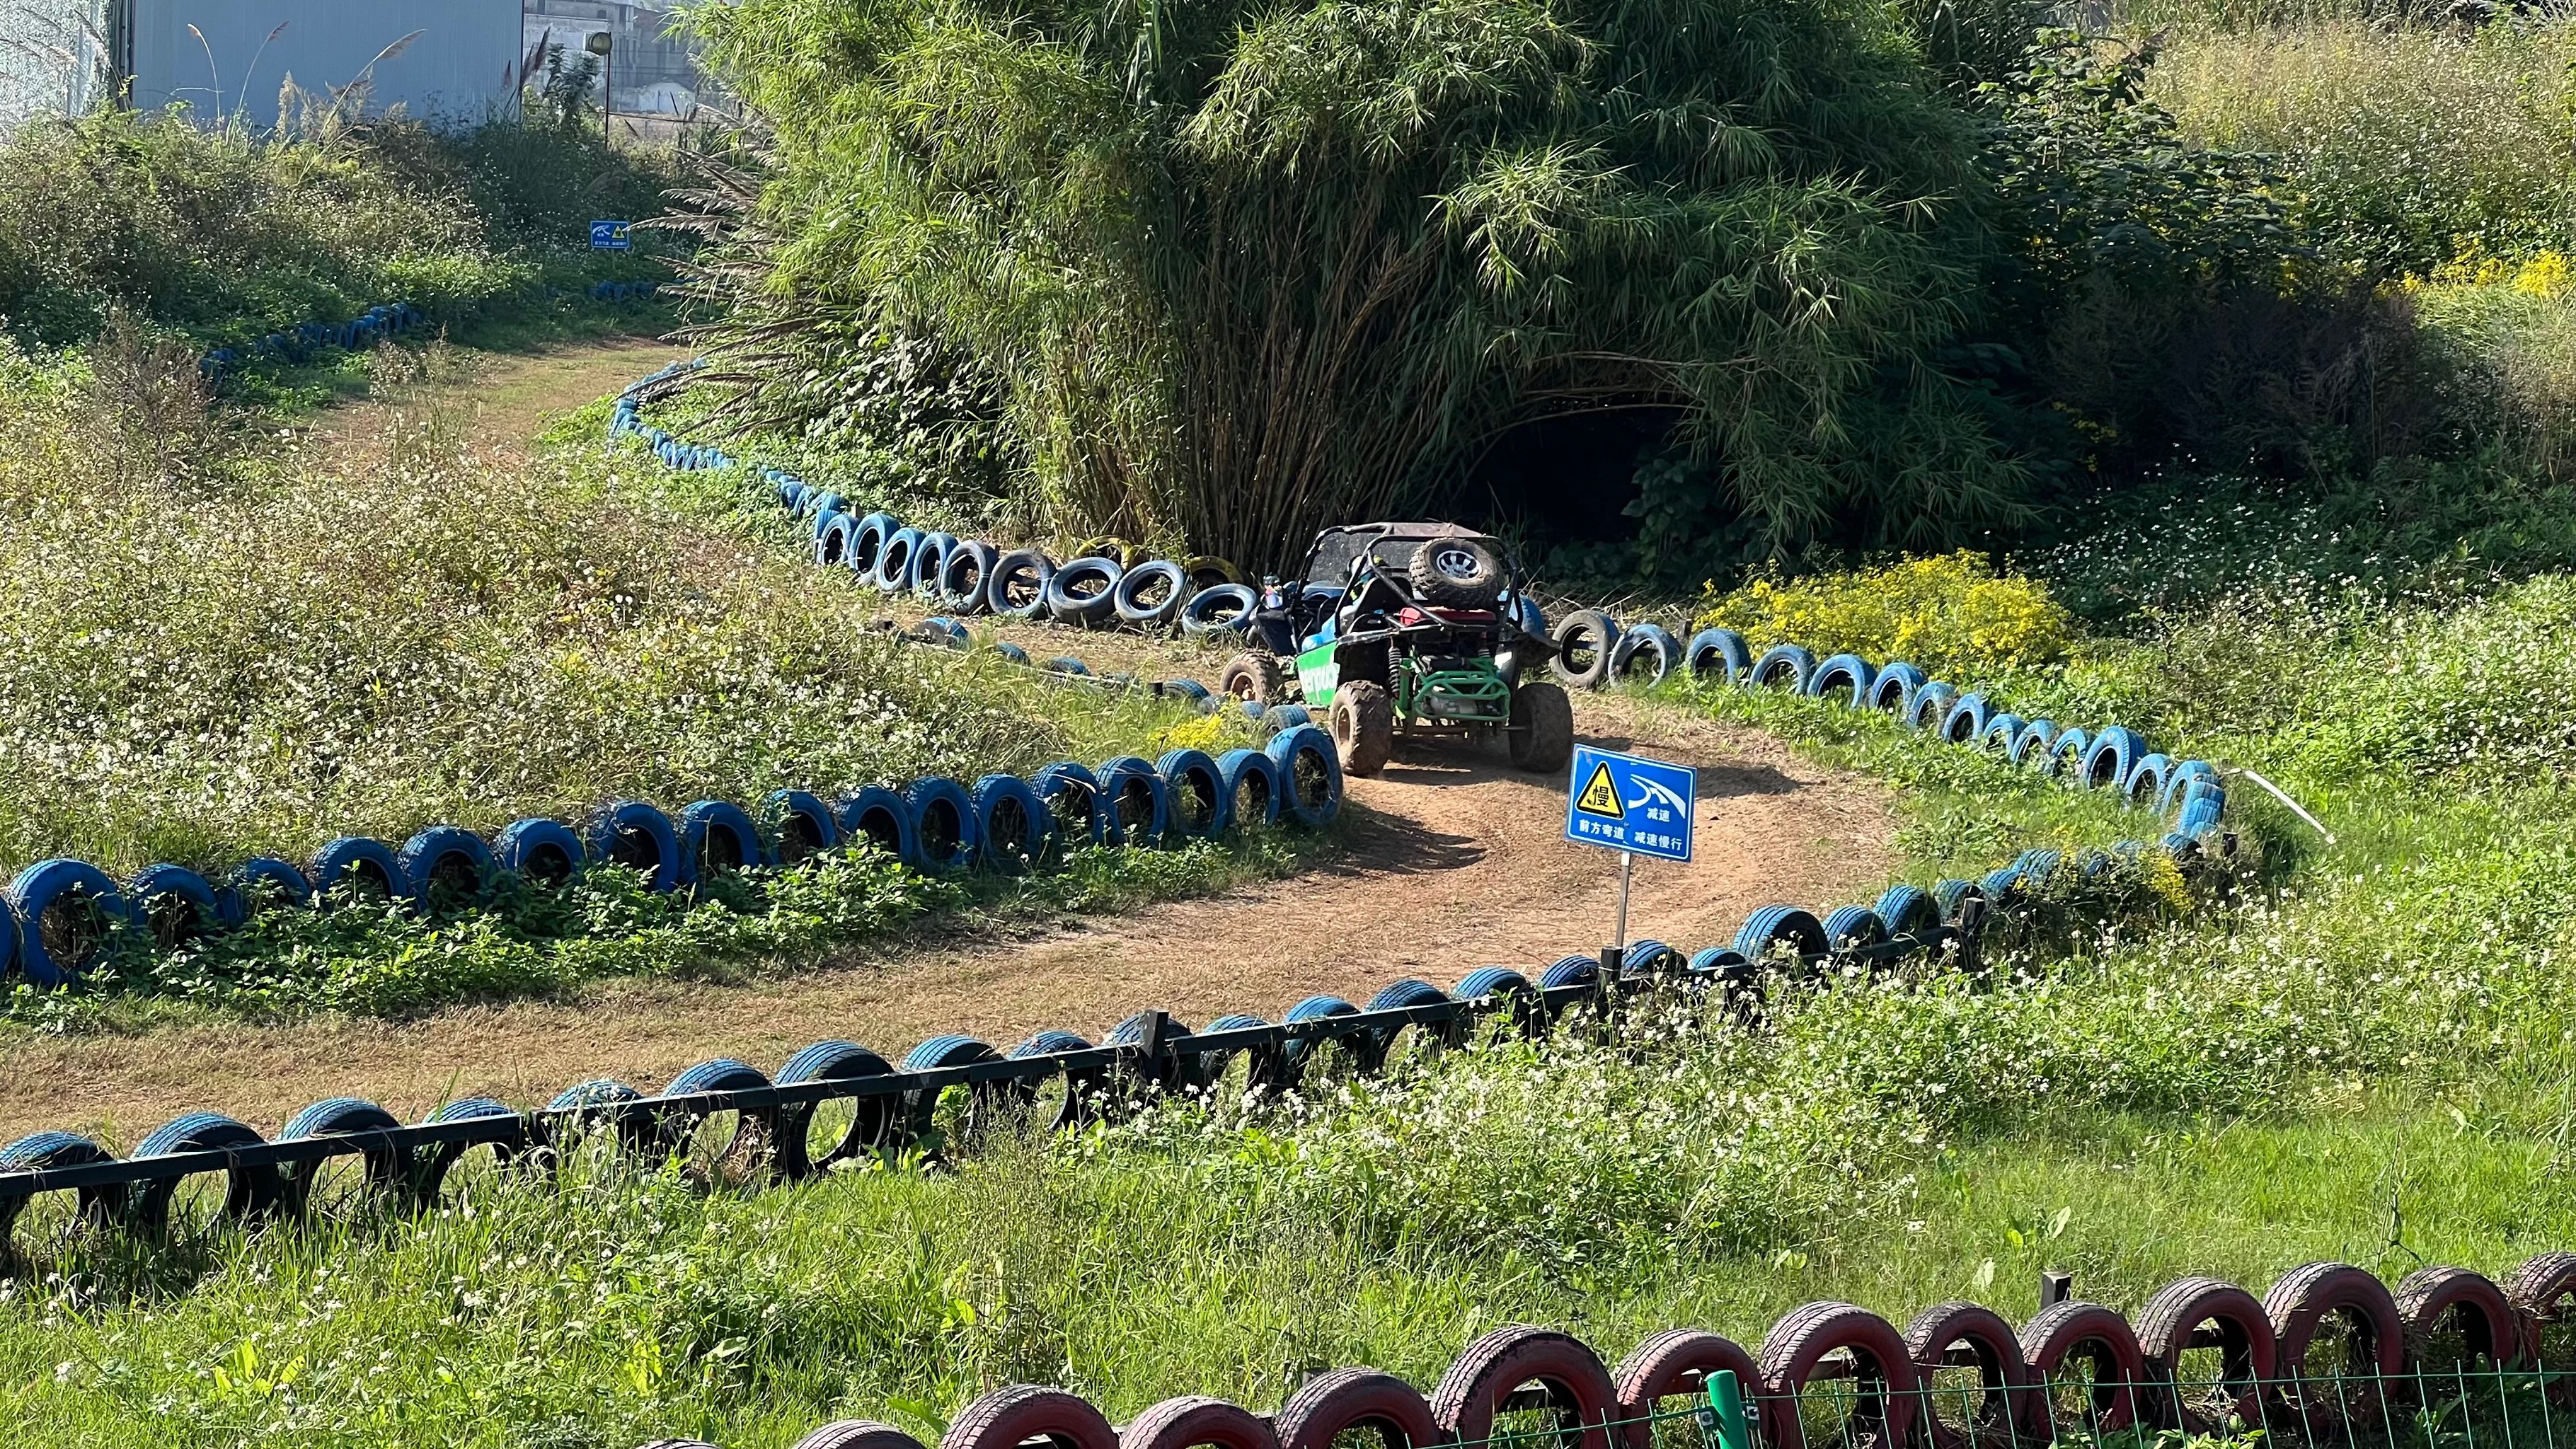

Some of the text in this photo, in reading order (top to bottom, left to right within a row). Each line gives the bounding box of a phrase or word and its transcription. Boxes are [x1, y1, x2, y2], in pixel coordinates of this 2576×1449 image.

[1590, 784, 1609, 807] 慢
[1646, 807, 1670, 822] 减速
[1579, 819, 1682, 850] 前方弯道 减速慢行
